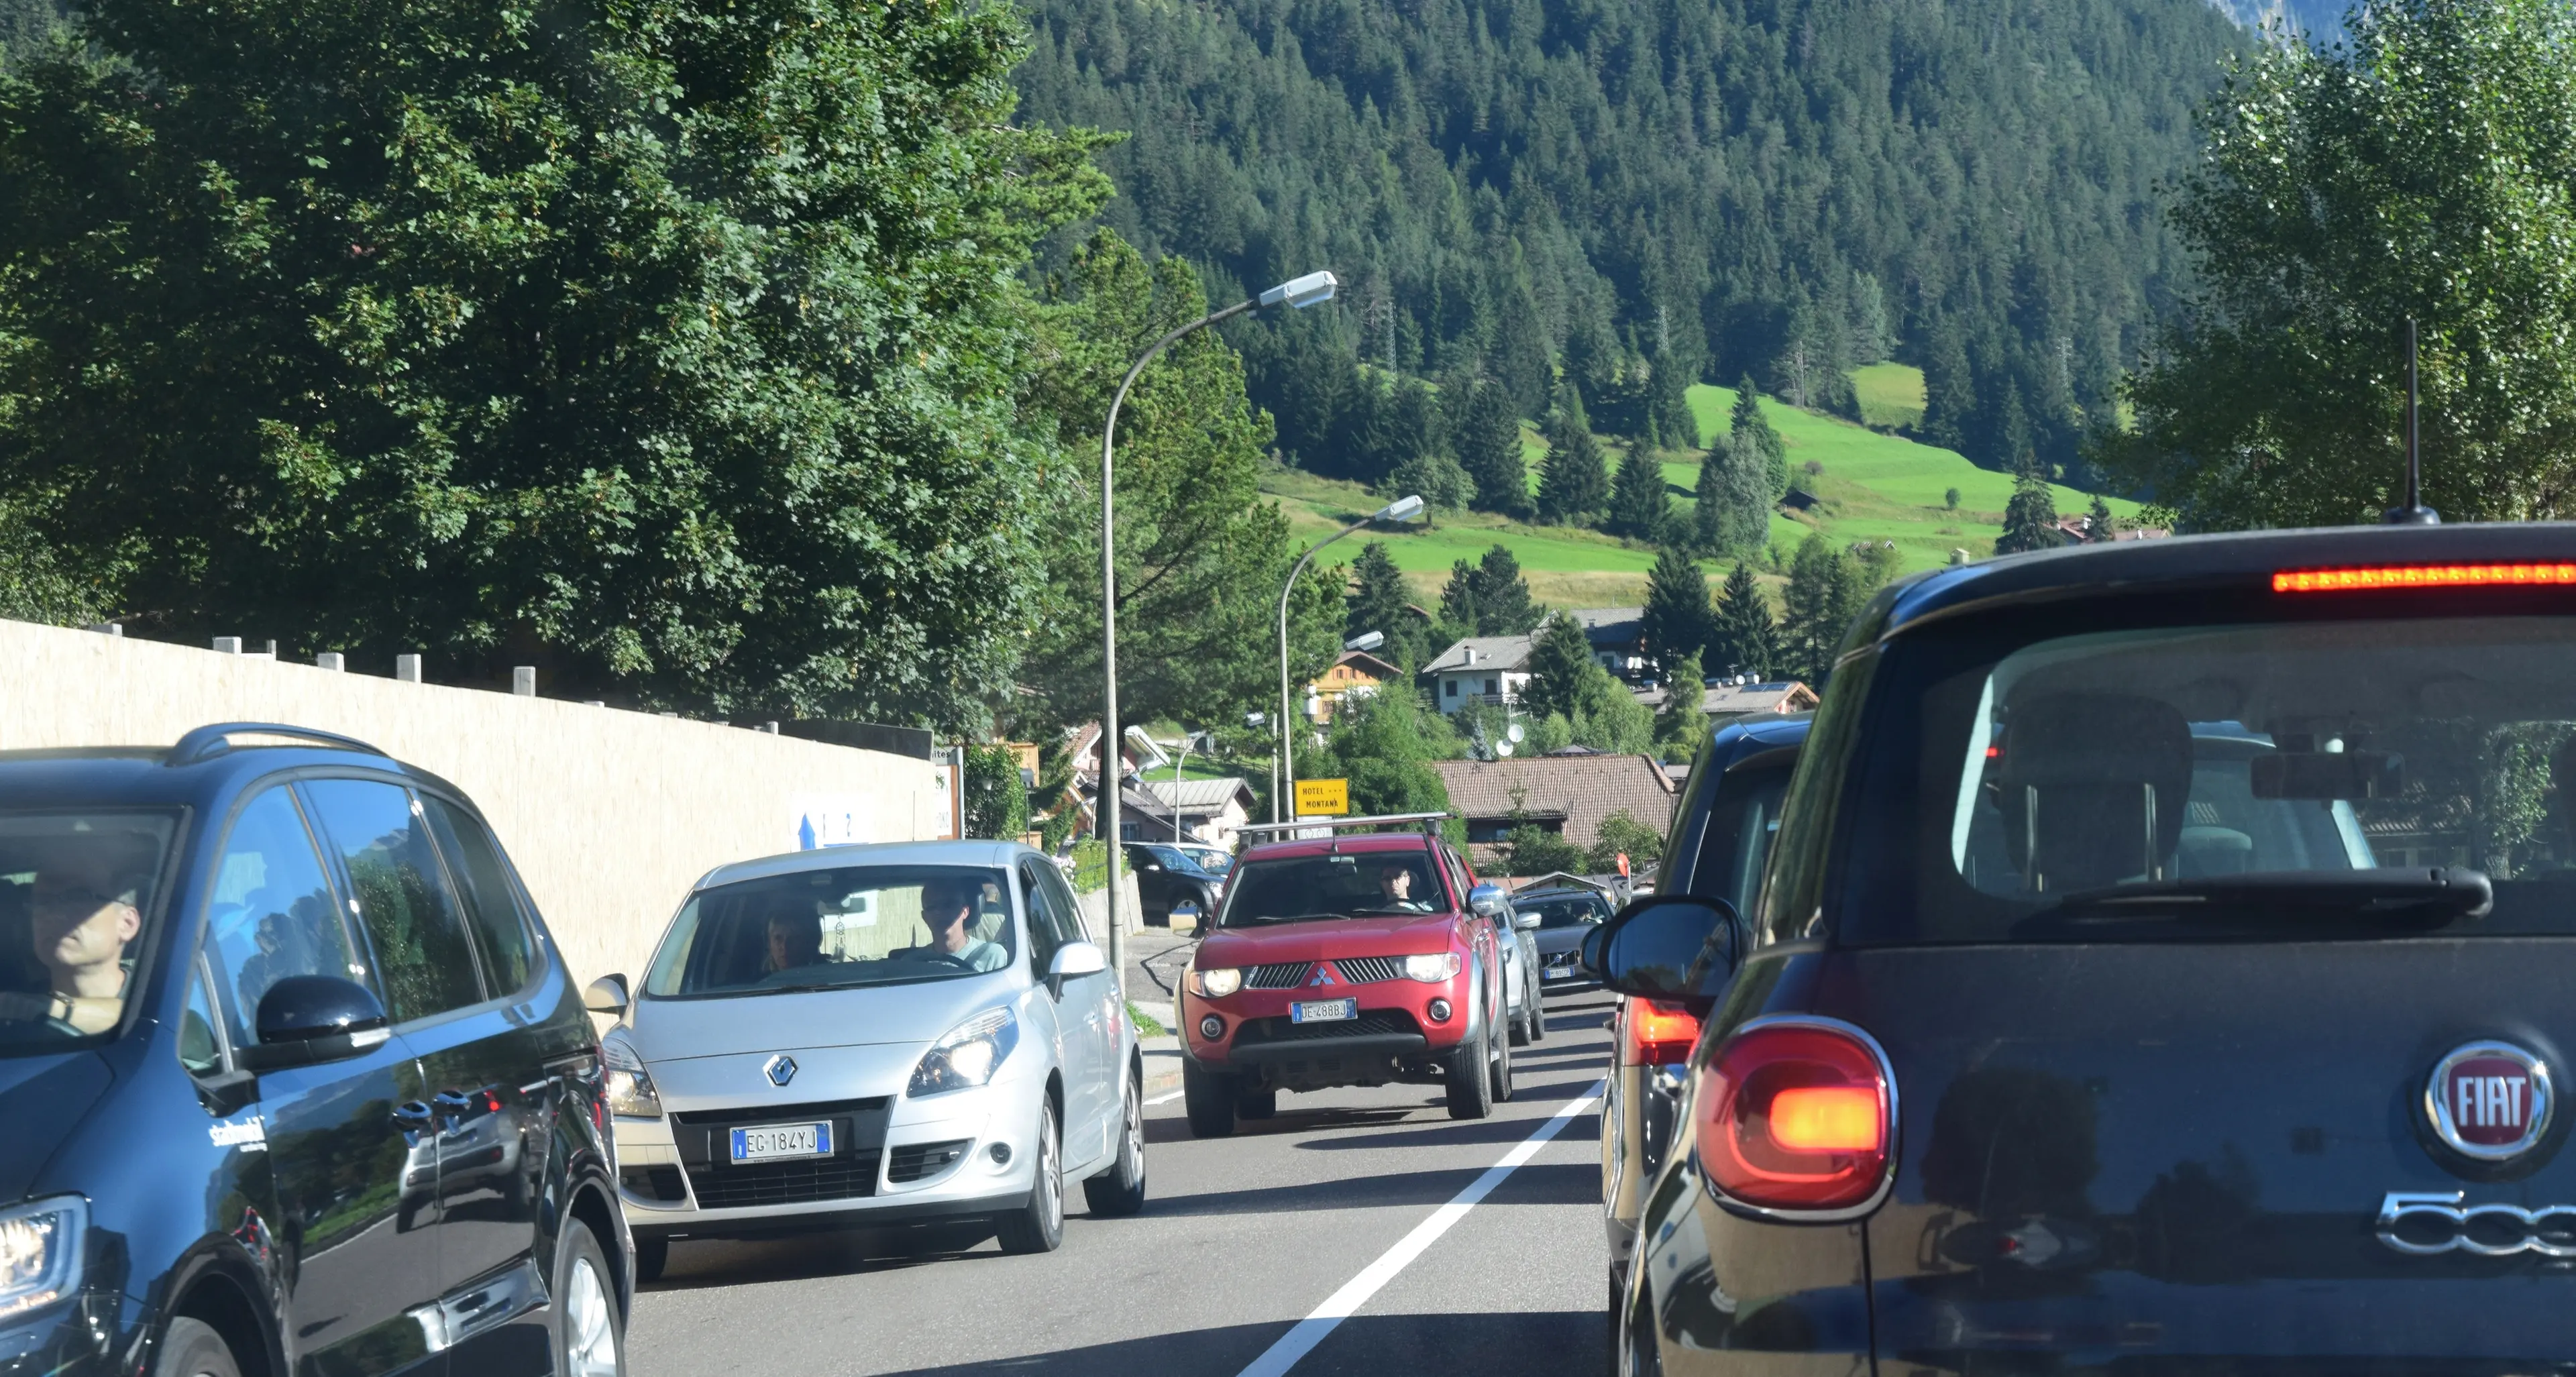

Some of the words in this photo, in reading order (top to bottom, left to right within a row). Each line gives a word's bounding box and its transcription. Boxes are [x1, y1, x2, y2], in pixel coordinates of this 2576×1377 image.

[1302, 787, 1324, 795] HOTEL
[1306, 800, 1338, 808] MONTANA
[2457, 1077, 2526, 1127] FIAT
